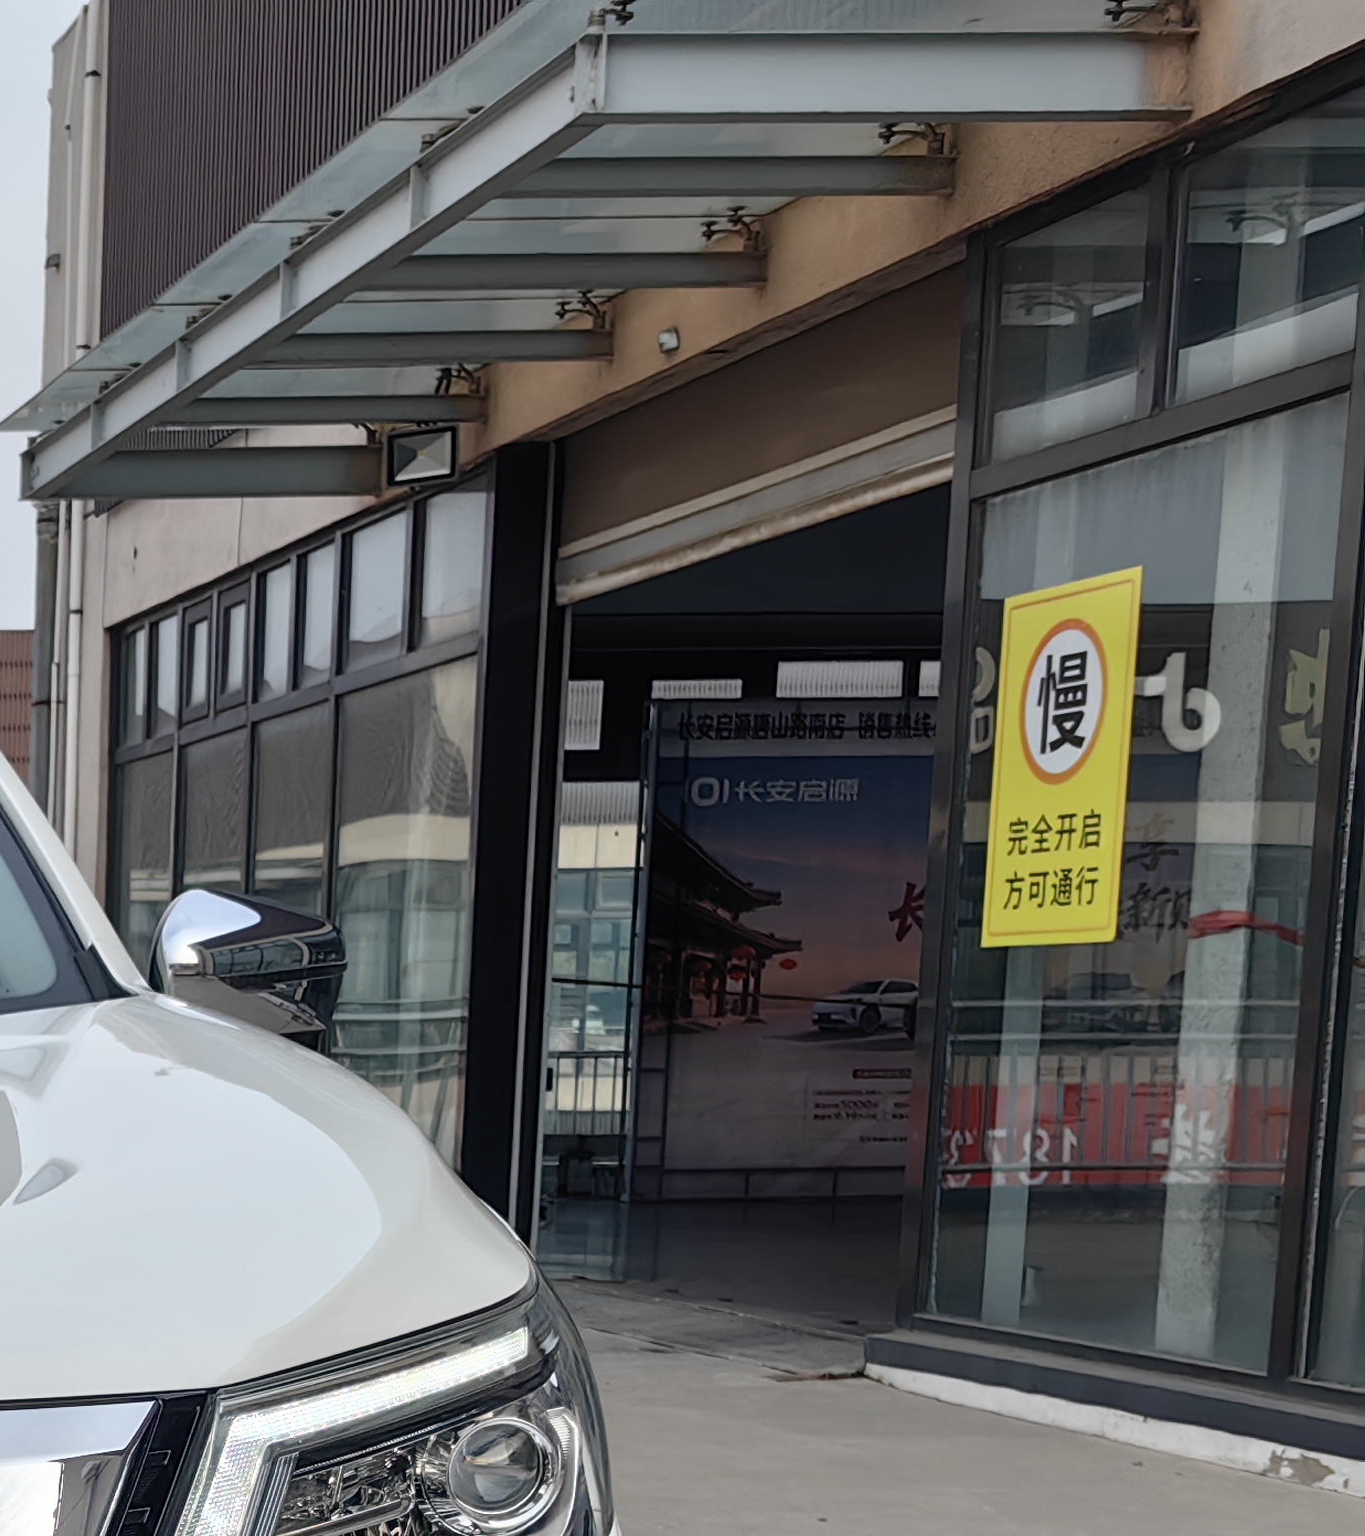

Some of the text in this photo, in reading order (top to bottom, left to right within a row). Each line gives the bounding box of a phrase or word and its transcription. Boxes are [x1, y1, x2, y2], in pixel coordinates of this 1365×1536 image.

[1037, 650, 1089, 756] 慢
[1006, 809, 1102, 856] 完全开启
[1003, 866, 1099, 910] 方可通行
